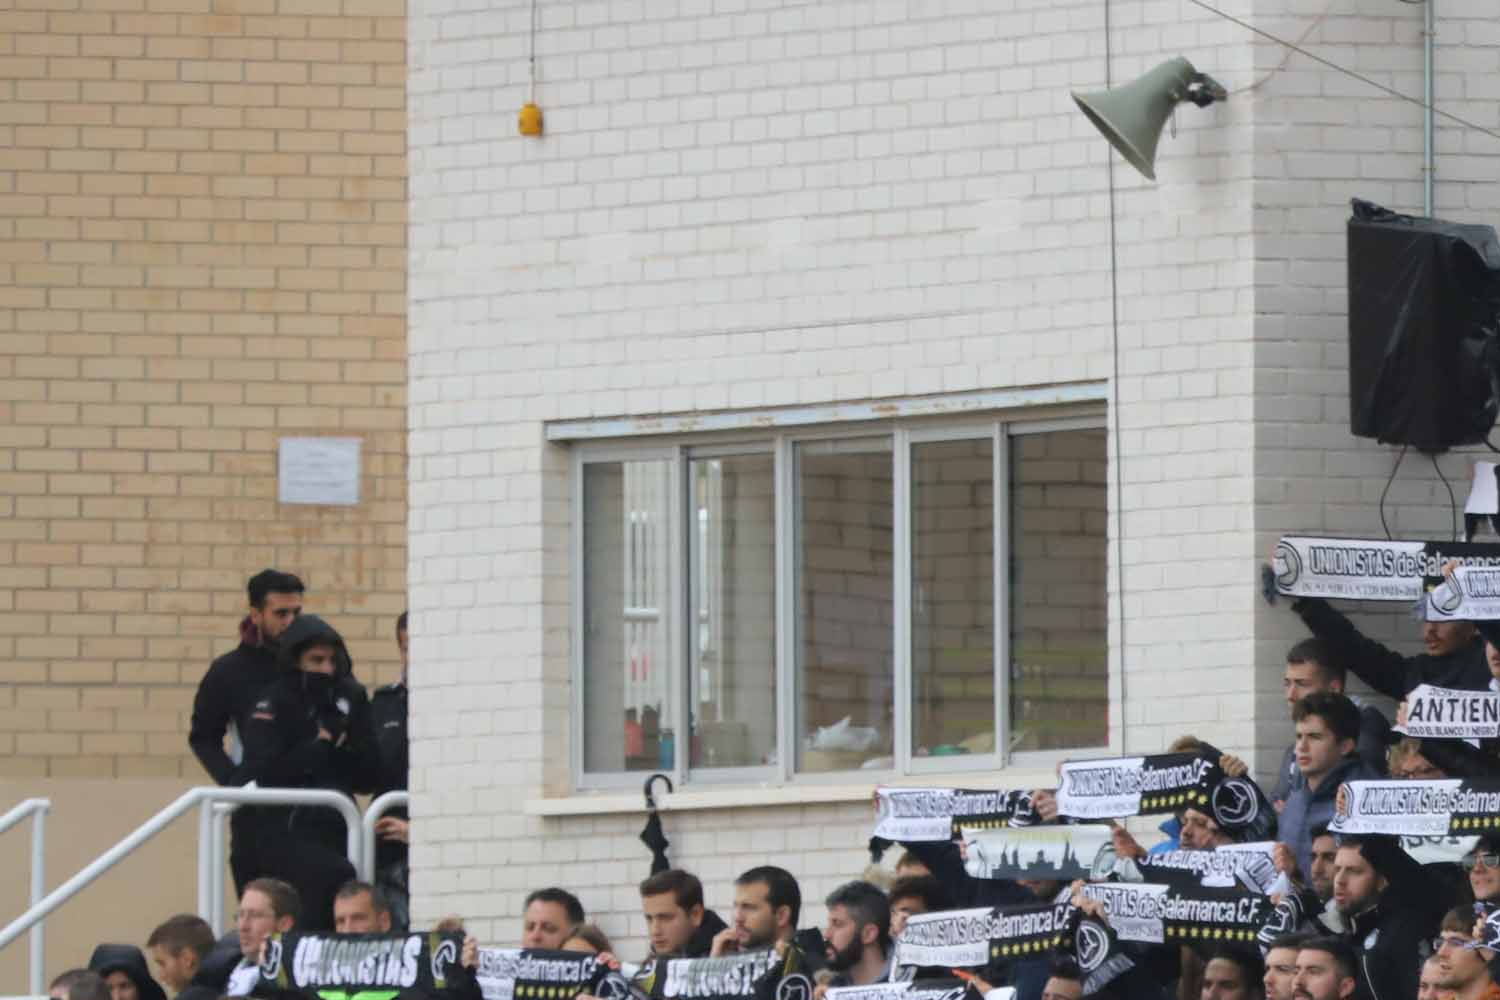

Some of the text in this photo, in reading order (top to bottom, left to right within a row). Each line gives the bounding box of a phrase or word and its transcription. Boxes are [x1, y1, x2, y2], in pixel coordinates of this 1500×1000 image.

[1309, 547, 1393, 577] UNIONISTAS
[1397, 551, 1418, 576] de
[1141, 763, 1190, 792] Salamanca
[1360, 787, 1432, 817] UNIONISTAS
[1432, 787, 1448, 813] de
[1138, 893, 1262, 924] de Salamanca C.F.
[985, 910, 1053, 940] Salamanca
